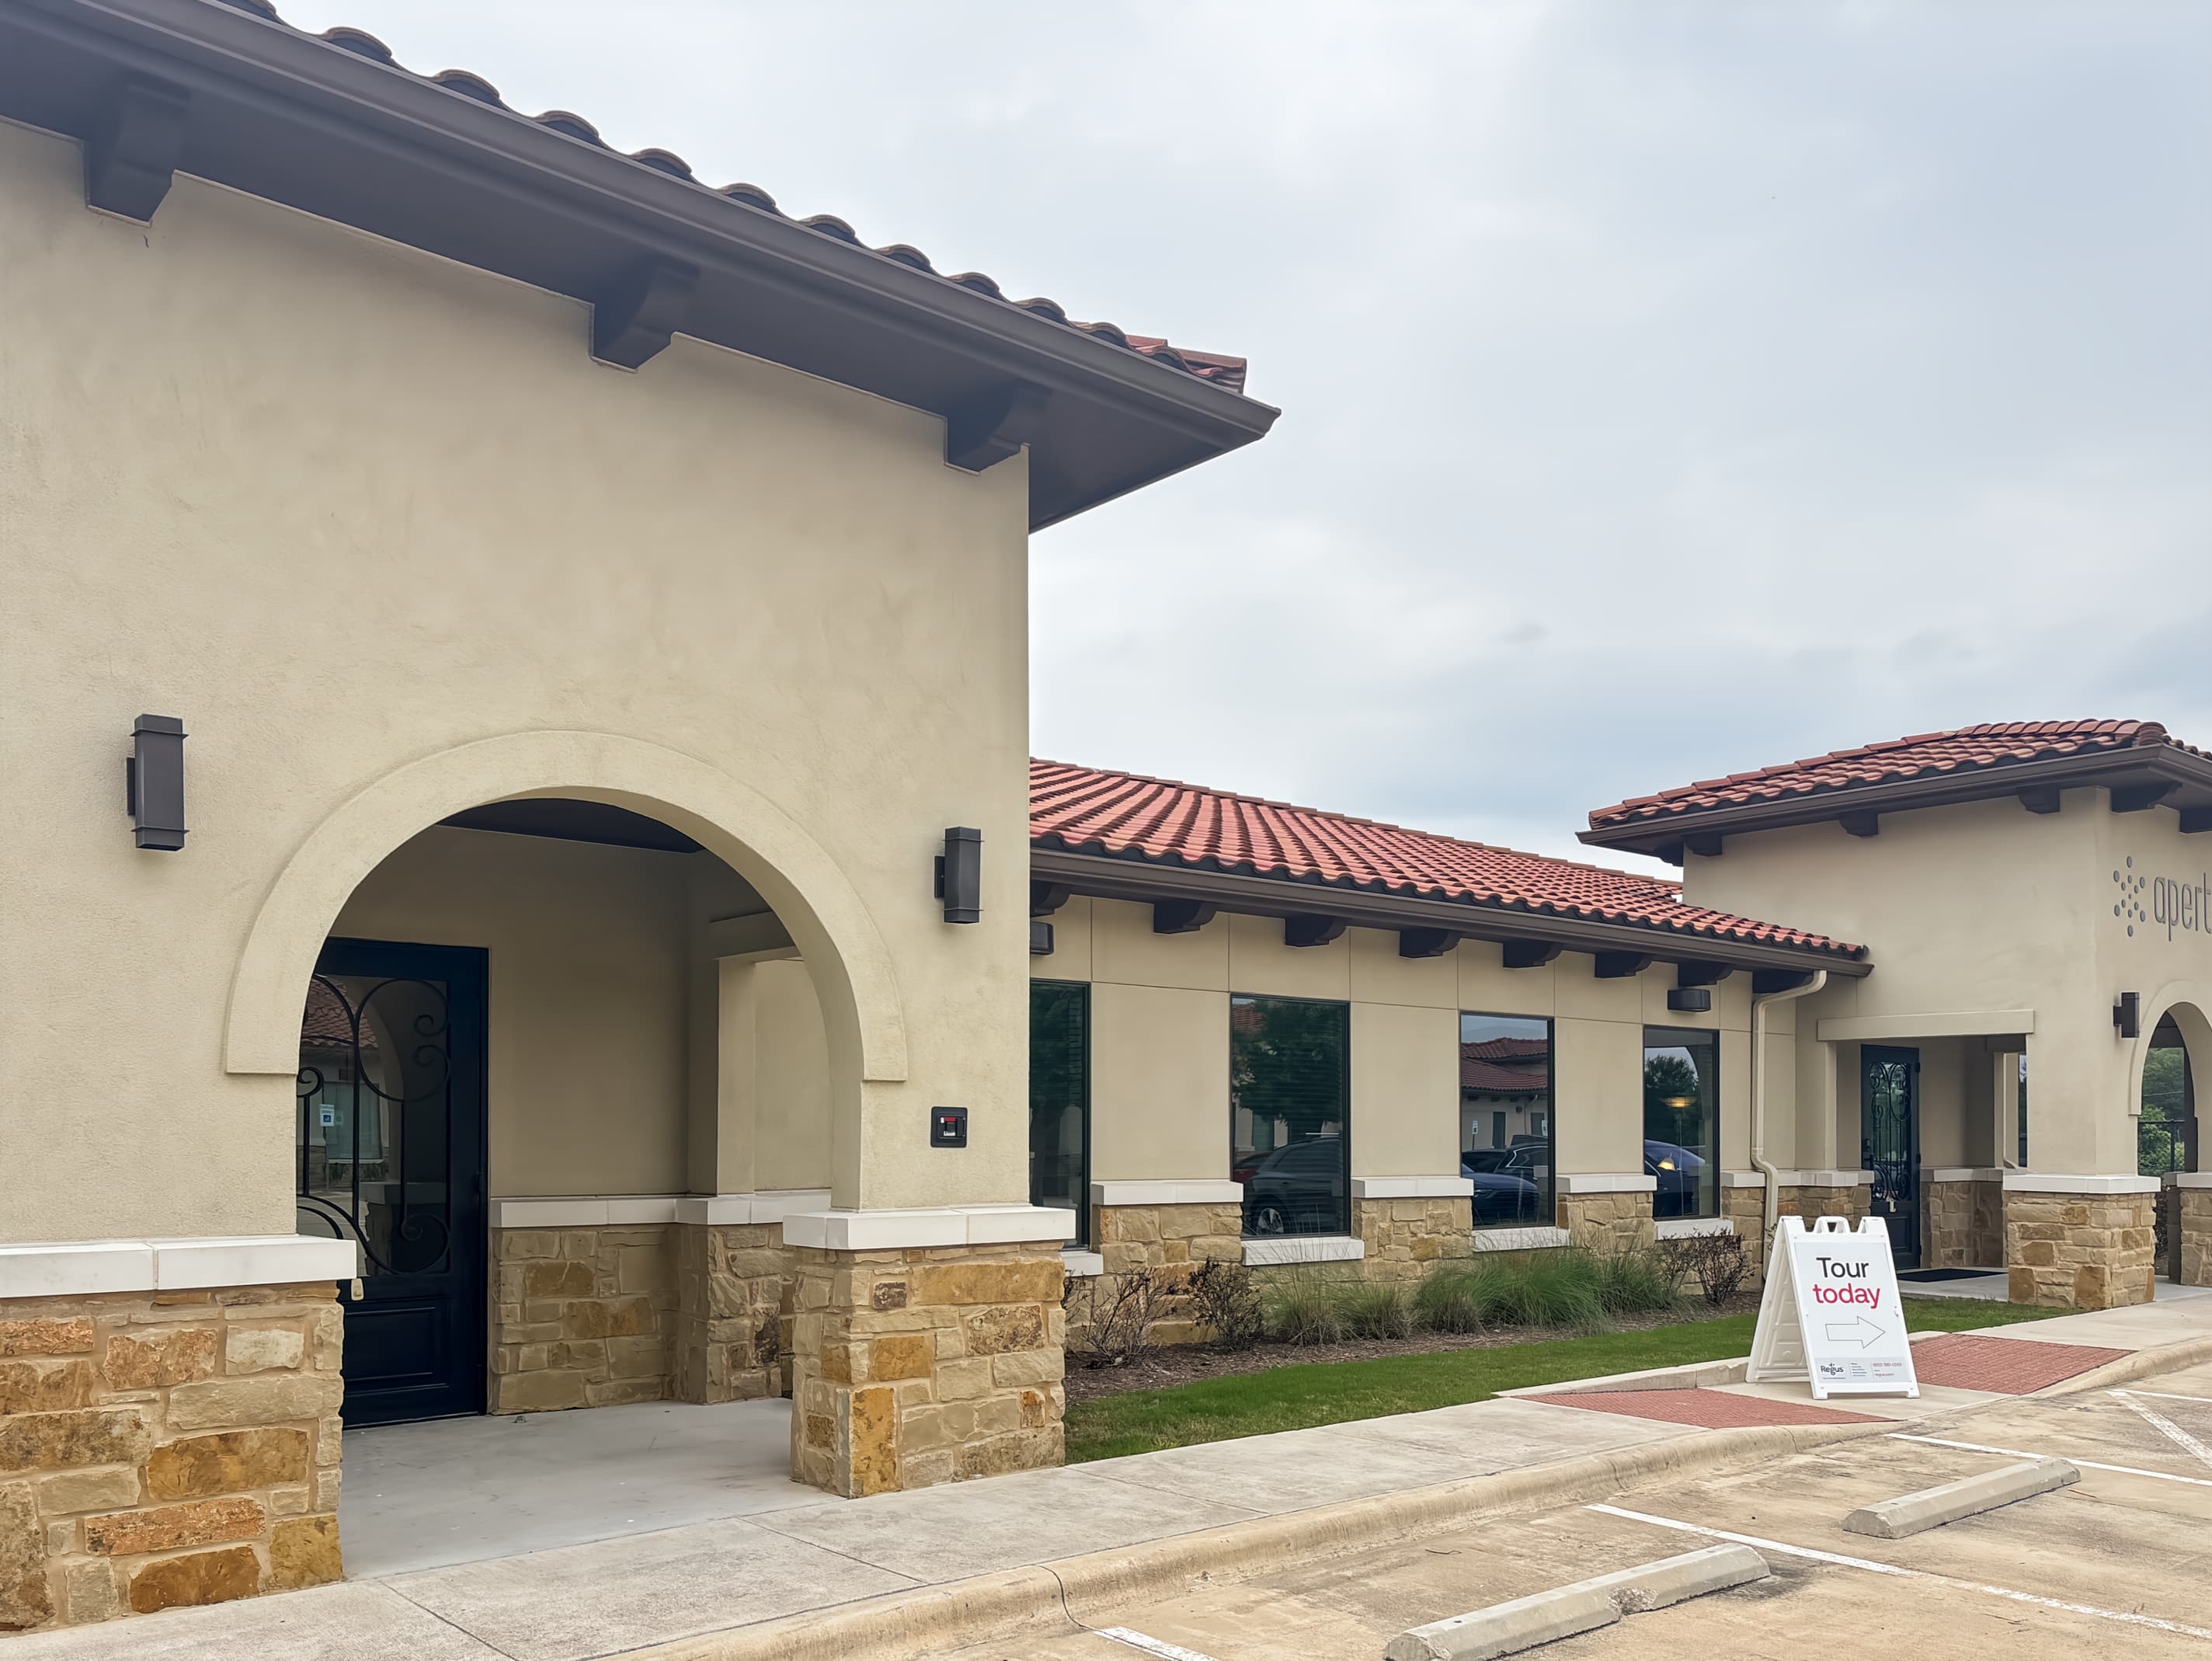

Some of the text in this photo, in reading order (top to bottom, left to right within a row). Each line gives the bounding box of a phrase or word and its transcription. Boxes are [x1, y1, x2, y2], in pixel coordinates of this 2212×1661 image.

[2154, 872, 2212, 942] apert
[1816, 1257, 1869, 1278] Tour
[1812, 1283, 1881, 1309] today
[1820, 1365, 1844, 1375] Regus
